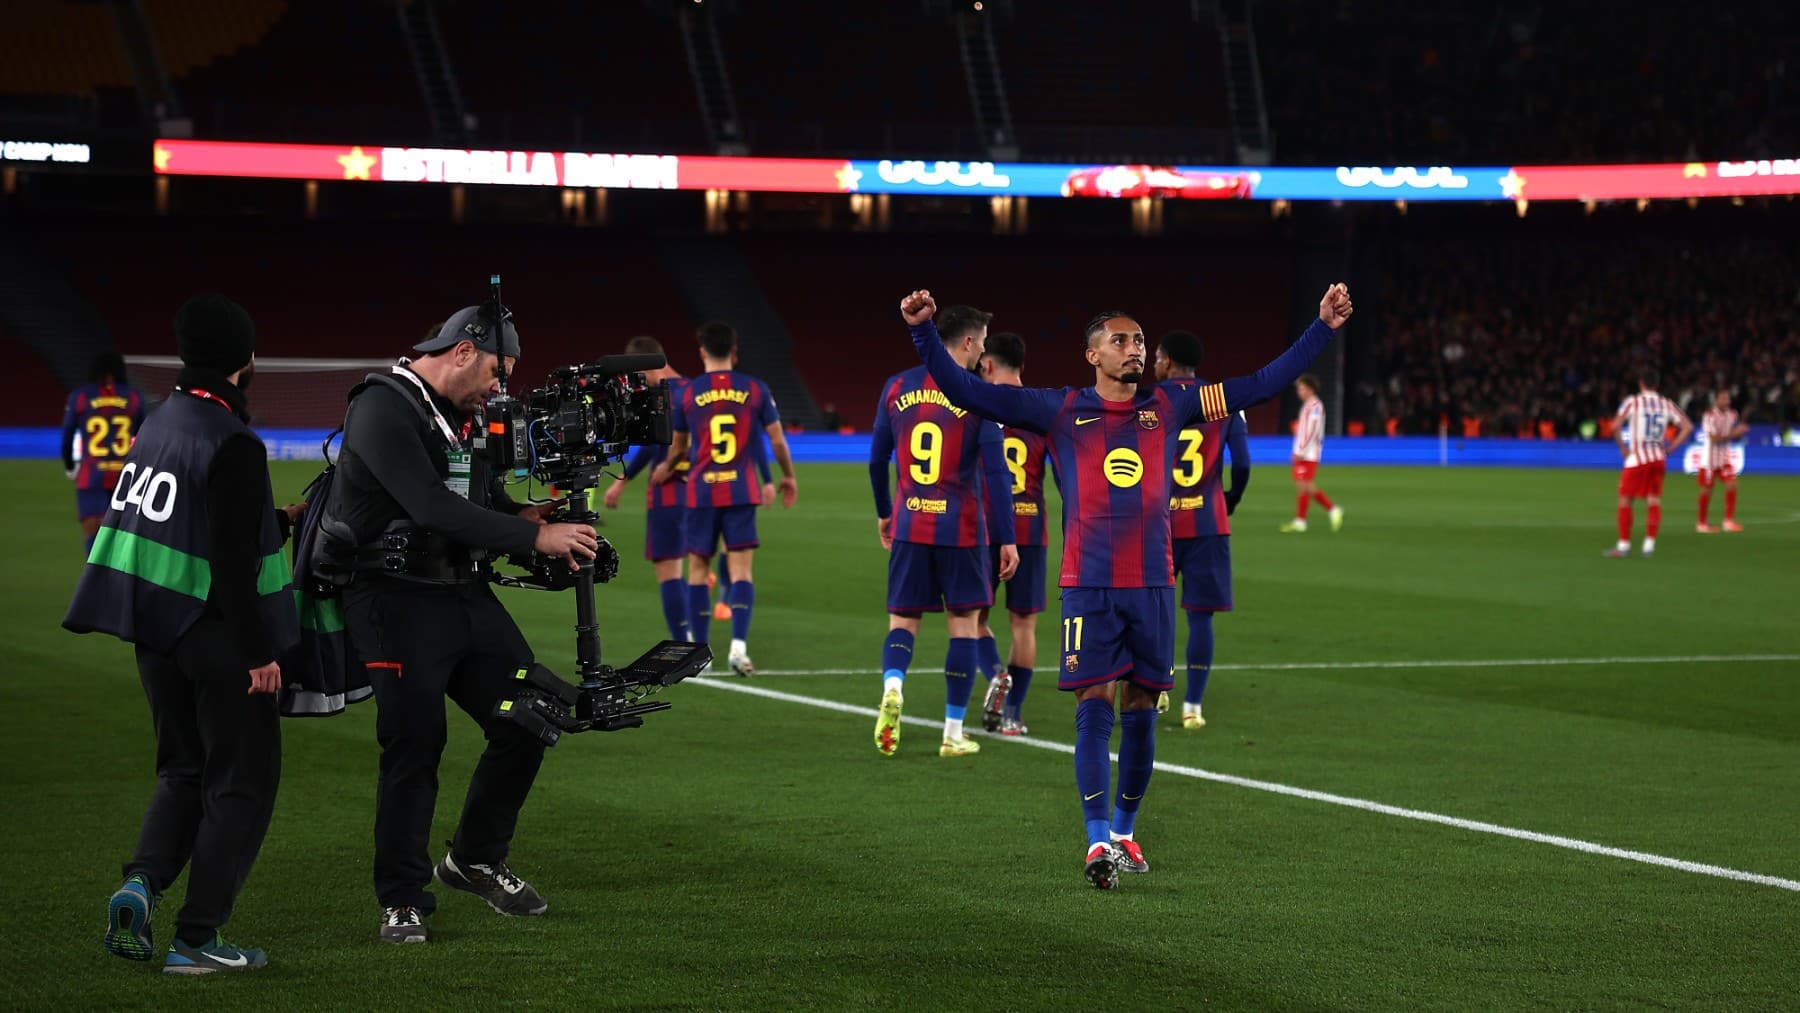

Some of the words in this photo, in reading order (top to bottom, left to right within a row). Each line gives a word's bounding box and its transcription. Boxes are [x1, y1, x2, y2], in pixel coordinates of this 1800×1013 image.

[86, 415, 132, 457] 23
[709, 414, 737, 464] 5
[1643, 412, 1664, 440] 15
[910, 421, 943, 485] 9
[1172, 428, 1204, 487] 3
[111, 462, 178, 522] 040
[1063, 616, 1084, 652] 11
